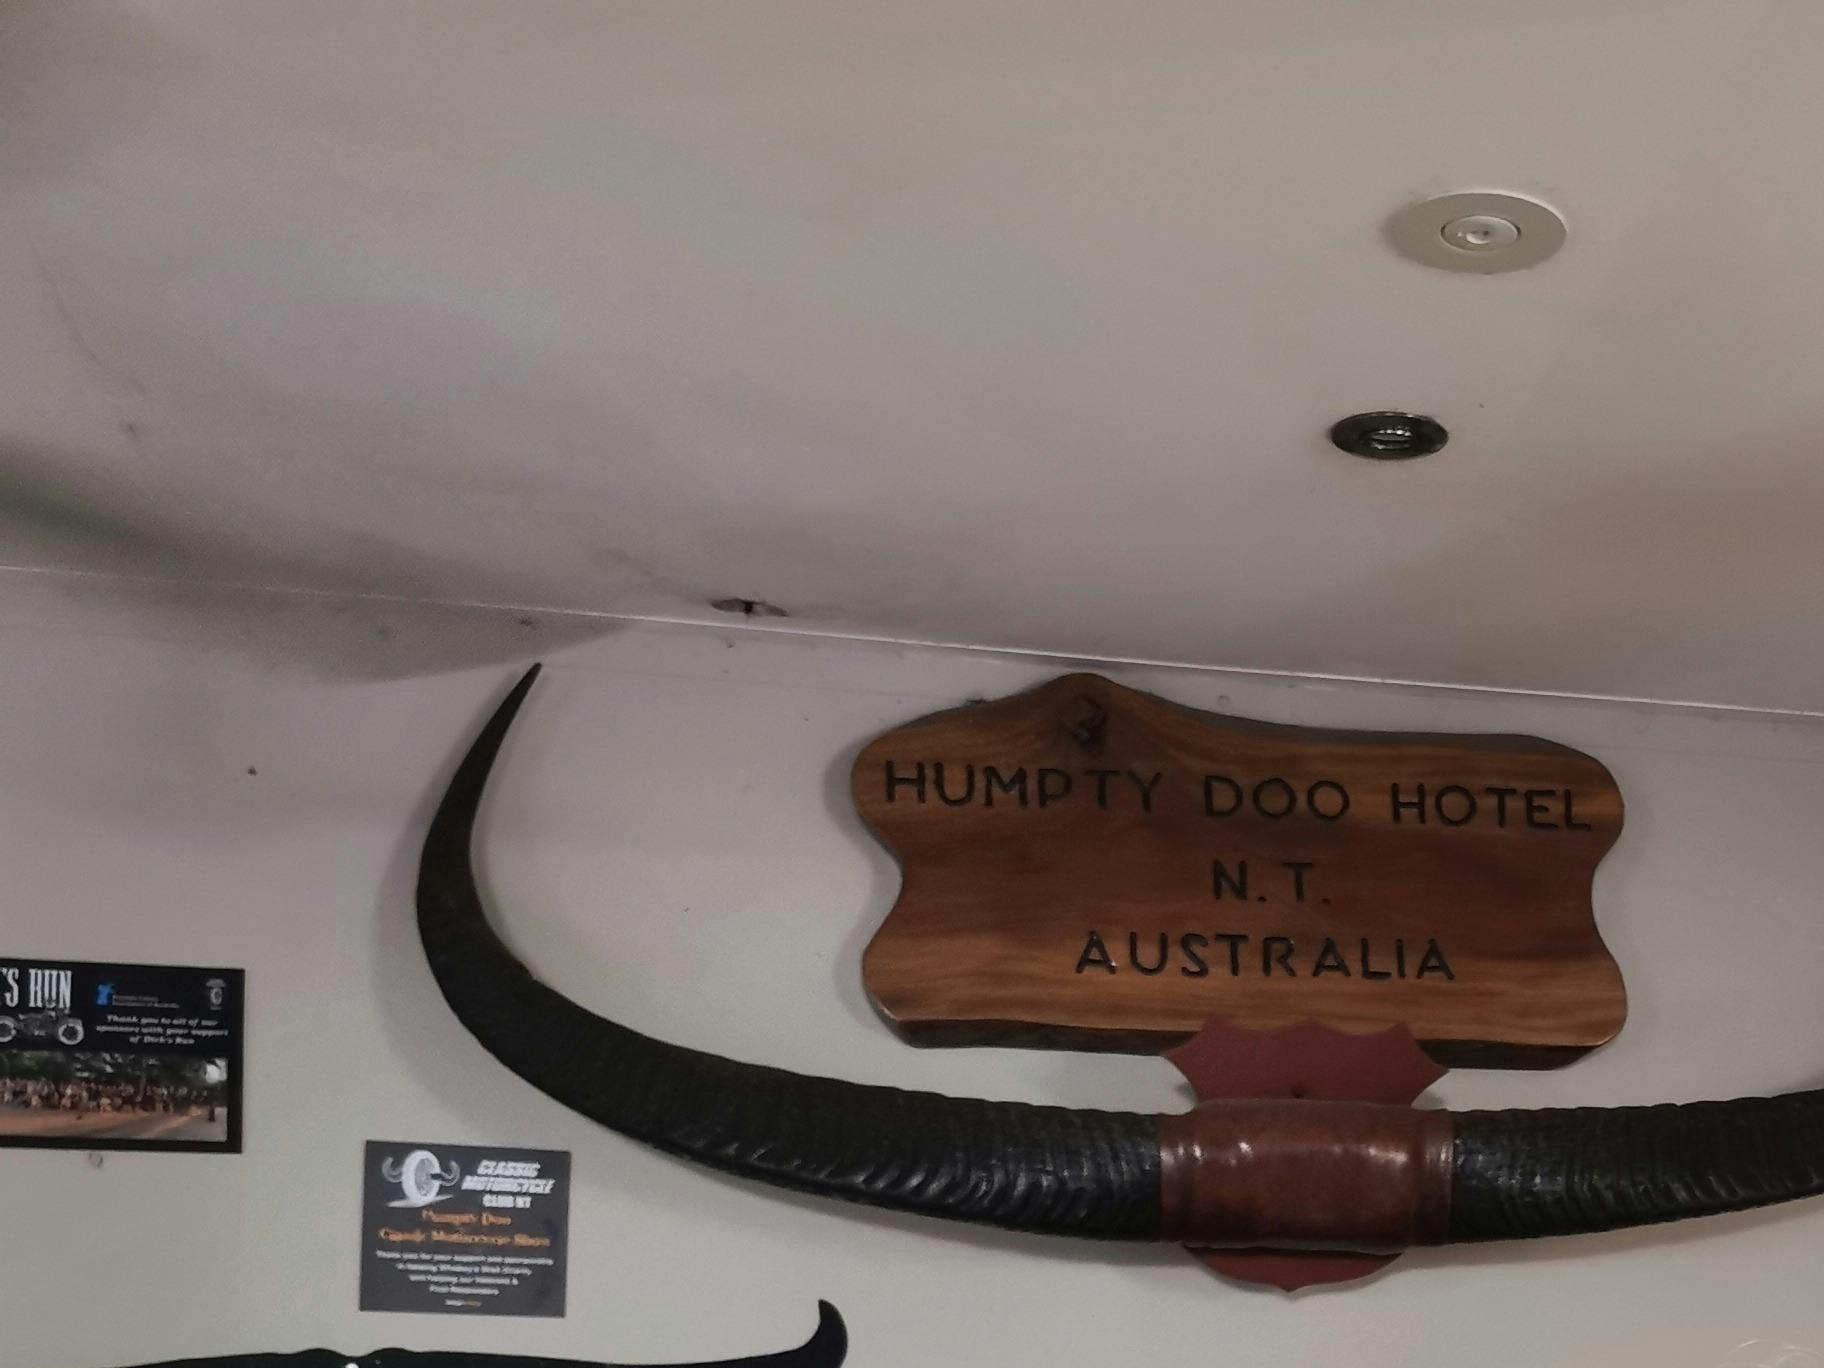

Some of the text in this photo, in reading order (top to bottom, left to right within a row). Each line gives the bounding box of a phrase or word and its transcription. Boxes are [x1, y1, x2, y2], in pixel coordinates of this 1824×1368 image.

[886, 761, 1592, 832] HUMPTY DOO HOTEL
[1075, 931, 1456, 981] AUSTRALIA
[28, 969, 72, 1010] RUN
